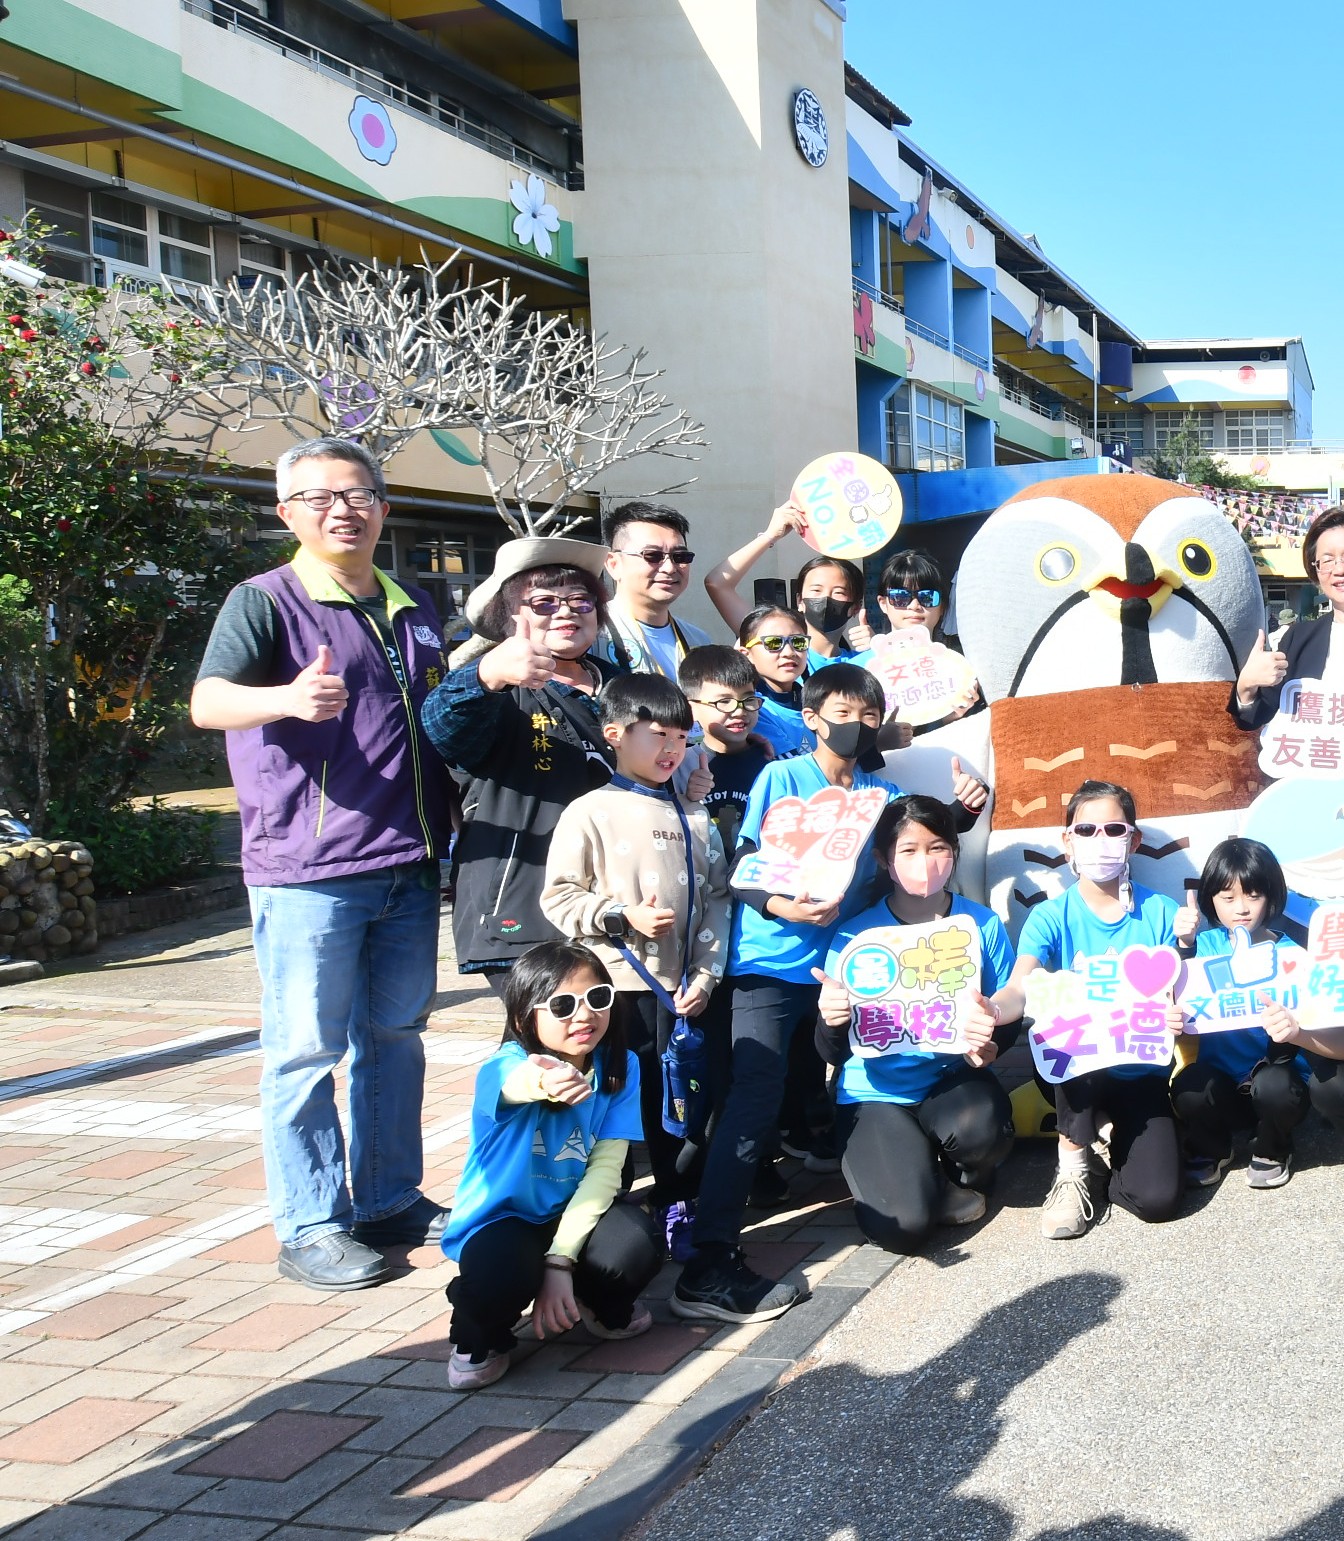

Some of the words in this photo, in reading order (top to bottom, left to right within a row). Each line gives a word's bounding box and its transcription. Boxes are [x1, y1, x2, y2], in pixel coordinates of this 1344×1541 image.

[885, 656, 938, 687] 文德
[852, 925, 977, 998] 最棒
[855, 998, 955, 1048] 學校
[1034, 1001, 1169, 1079] 文德
